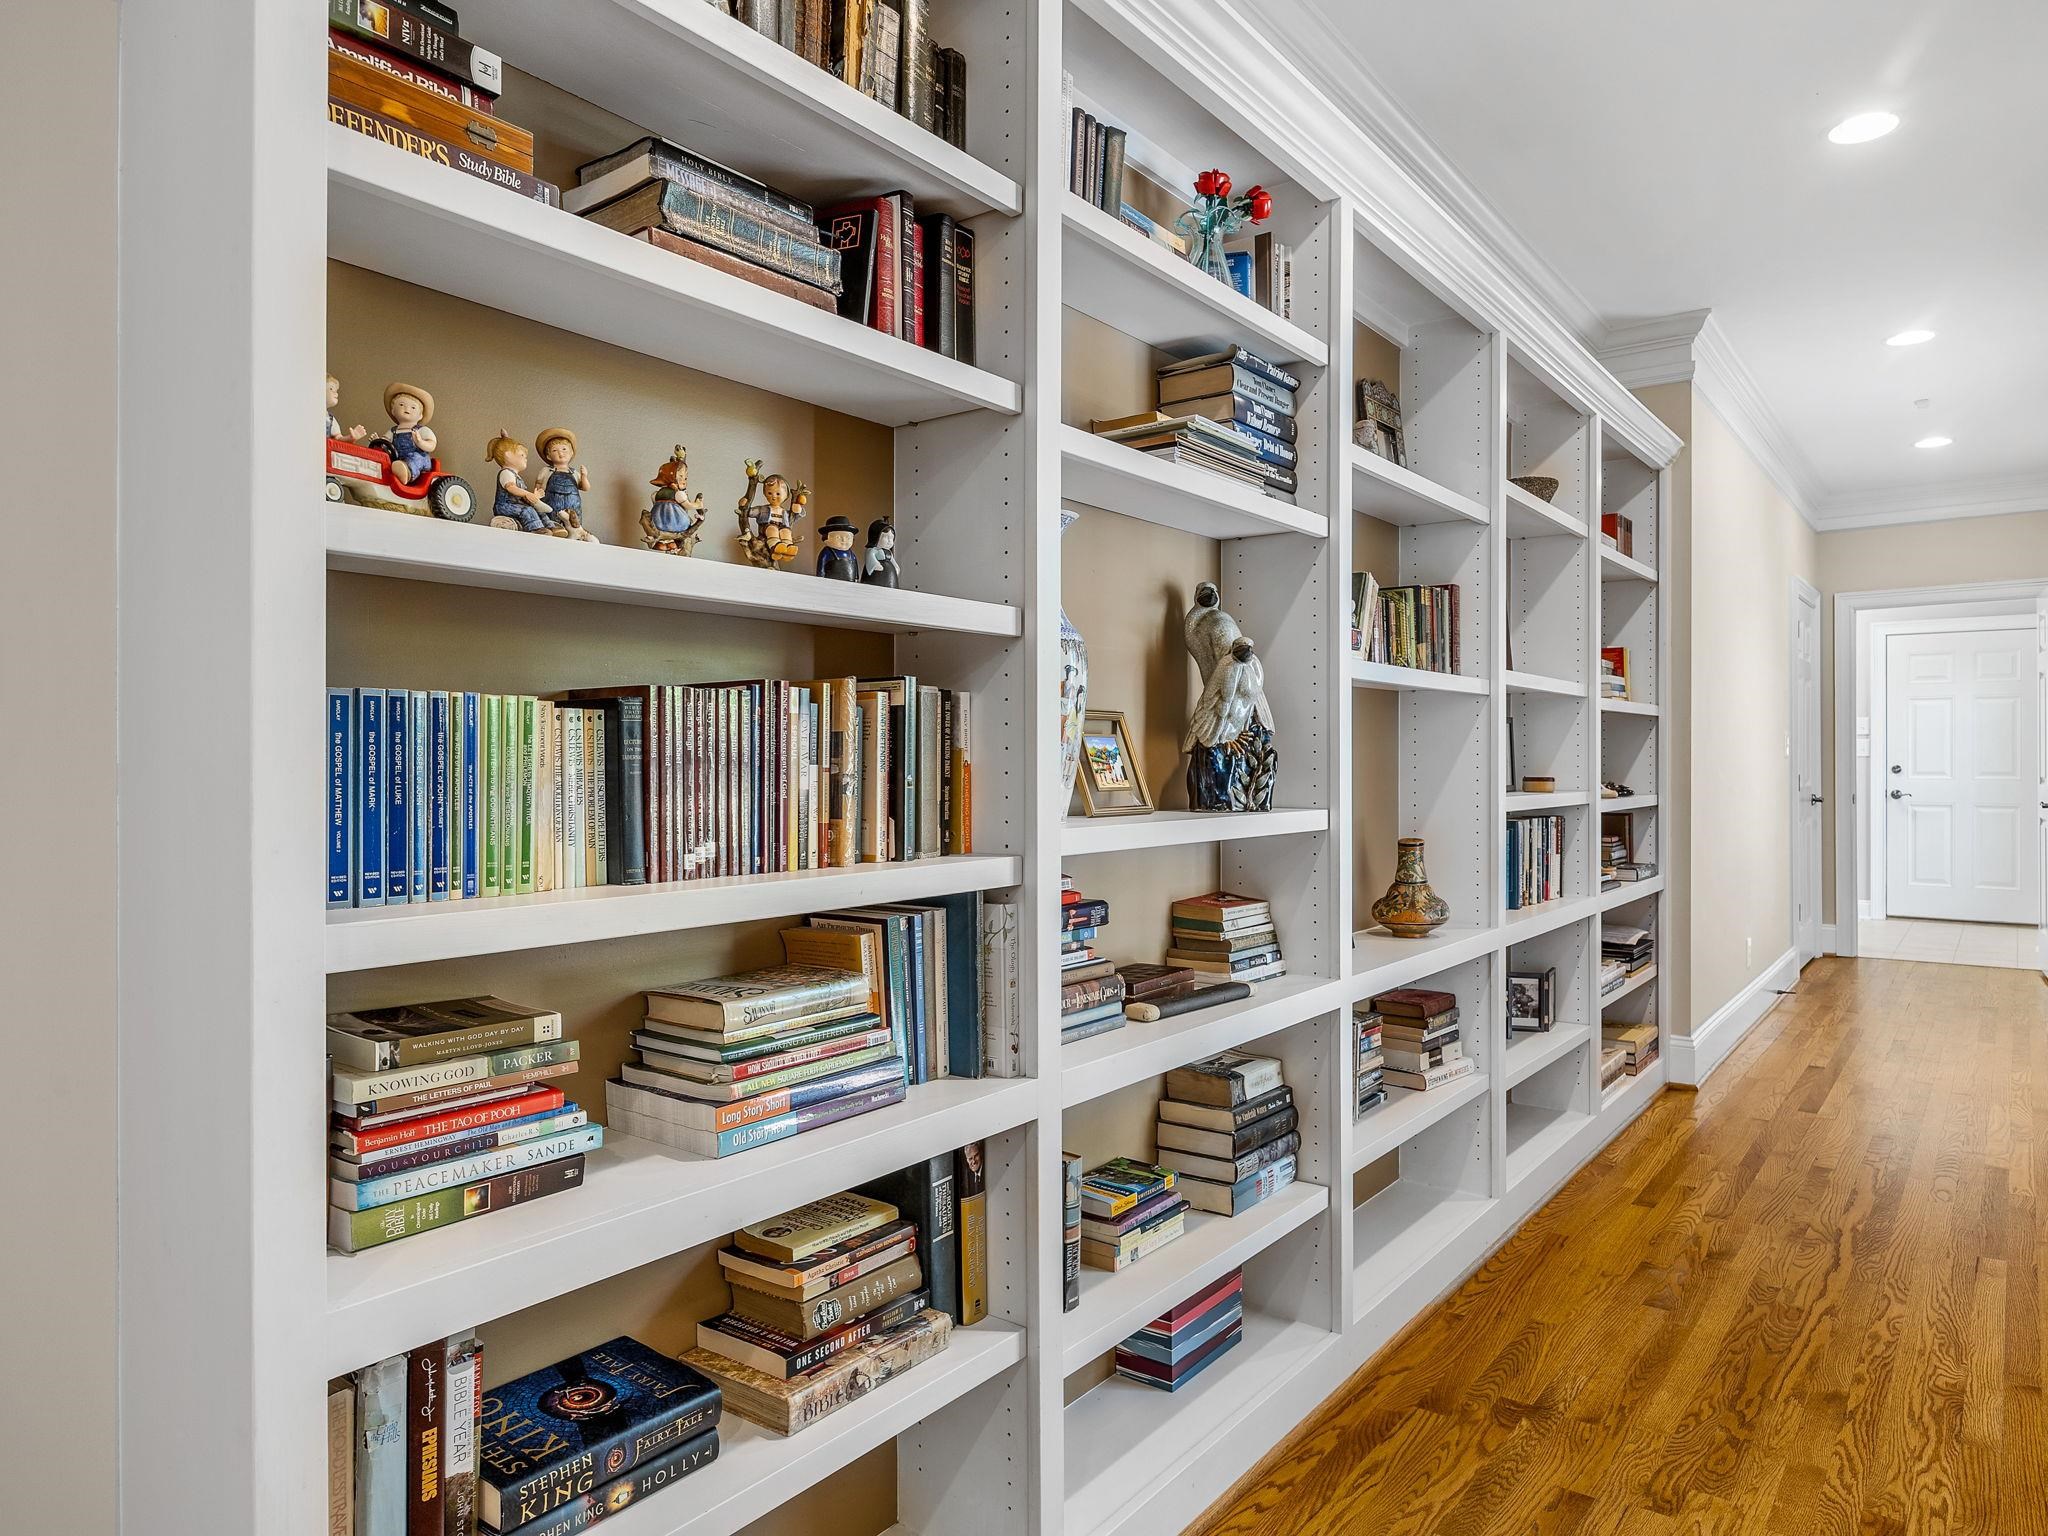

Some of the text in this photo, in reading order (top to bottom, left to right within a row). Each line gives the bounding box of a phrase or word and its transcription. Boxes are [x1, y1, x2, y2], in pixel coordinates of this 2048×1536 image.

[327, 101, 450, 167] EFENDER'S
[459, 153, 521, 189] Study Bible
[681, 155, 733, 184] HOLY BIBLE
[800, 714, 809, 777] LOVE WAR
[335, 778, 342, 786] of
[369, 777, 375, 785] of
[395, 776, 401, 784] of
[437, 775, 444, 783] of
[587, 770, 595, 785] THE
[783, 774, 788, 783] of
[587, 787, 595, 821] PROBLEM
[1009, 954, 1017, 973] Ology
[412, 1039, 445, 1049] WALKING
[447, 1036, 465, 1044] WITH
[436, 1040, 504, 1056] MARTYN LLOYD-JONES
[503, 1050, 553, 1070] PACKER
[522, 1068, 554, 1081] HEMPHILL
[747, 1057, 854, 1092] ALL NEW SQUARE FOOT GARDENING
[748, 1058, 784, 1075] HOW SHOULD
[367, 1065, 476, 1096] KNOWING GOD
[412, 1081, 493, 1103] THE LETTERS OF PAUL
[424, 1105, 521, 1136] THE TAO OF POOH
[722, 1096, 786, 1126] Long Story Short
[365, 1128, 418, 1148] Benjamin Hoff
[384, 1133, 457, 1156] ERNEST HEMINGWAY
[479, 1126, 488, 1134] Old
[502, 1131, 528, 1142] Charles
[732, 1126, 769, 1146] Old Story
[367, 1160, 399, 1176] YOU
[411, 1148, 452, 1164] YOUR
[454, 1138, 494, 1153] CHILD
[527, 1139, 575, 1161] SANDE
[373, 1154, 516, 1198] THE PEACEMAKER
[385, 1207, 397, 1238] DAILY
[395, 1205, 405, 1235] BIBLE
[807, 1268, 823, 1280] Agatha
[796, 1323, 872, 1371] ONE SECOND AFTER
[592, 1351, 700, 1400] FAIRY TALE
[803, 1388, 847, 1422] BIBLE
[453, 1376, 467, 1465] BIBLE YEAR
[480, 1396, 569, 1462] KING
[631, 1413, 704, 1468] FAIRY TALE
[422, 1427, 438, 1502] EPHESIANS
[519, 1452, 594, 1501] STEPHEN
[642, 1452, 700, 1493] HOLLY
[519, 1471, 595, 1526] KING
[539, 1502, 604, 1536] PHEN KING
